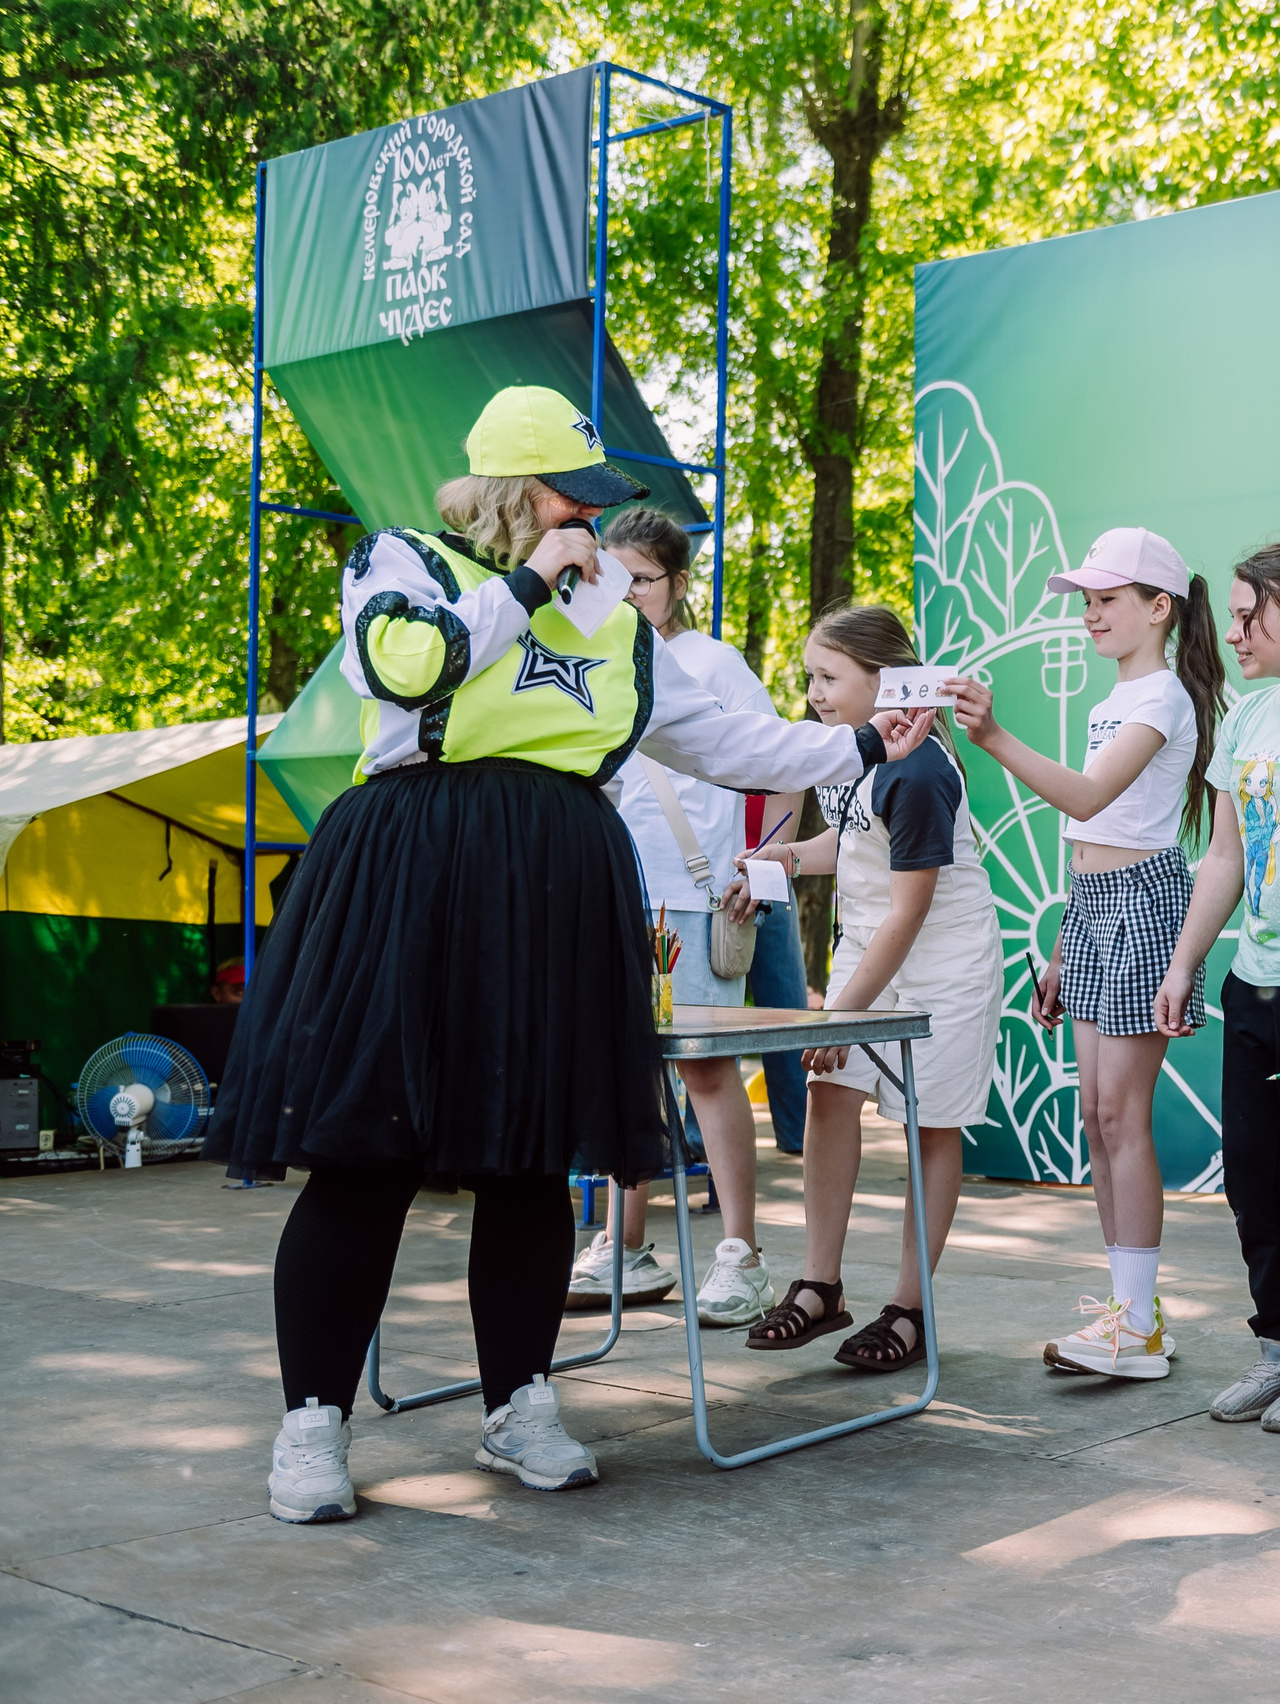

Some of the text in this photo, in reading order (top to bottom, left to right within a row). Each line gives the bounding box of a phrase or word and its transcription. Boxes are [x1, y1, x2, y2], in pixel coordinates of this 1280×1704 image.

[392, 141, 430, 183] 100
[363, 115, 477, 281] КЕМЕРОВСКИЙ ГОРОДСКОЙ САД
[386, 262, 448, 305] ПАРК
[379, 297, 453, 347] ЧУДЕС
